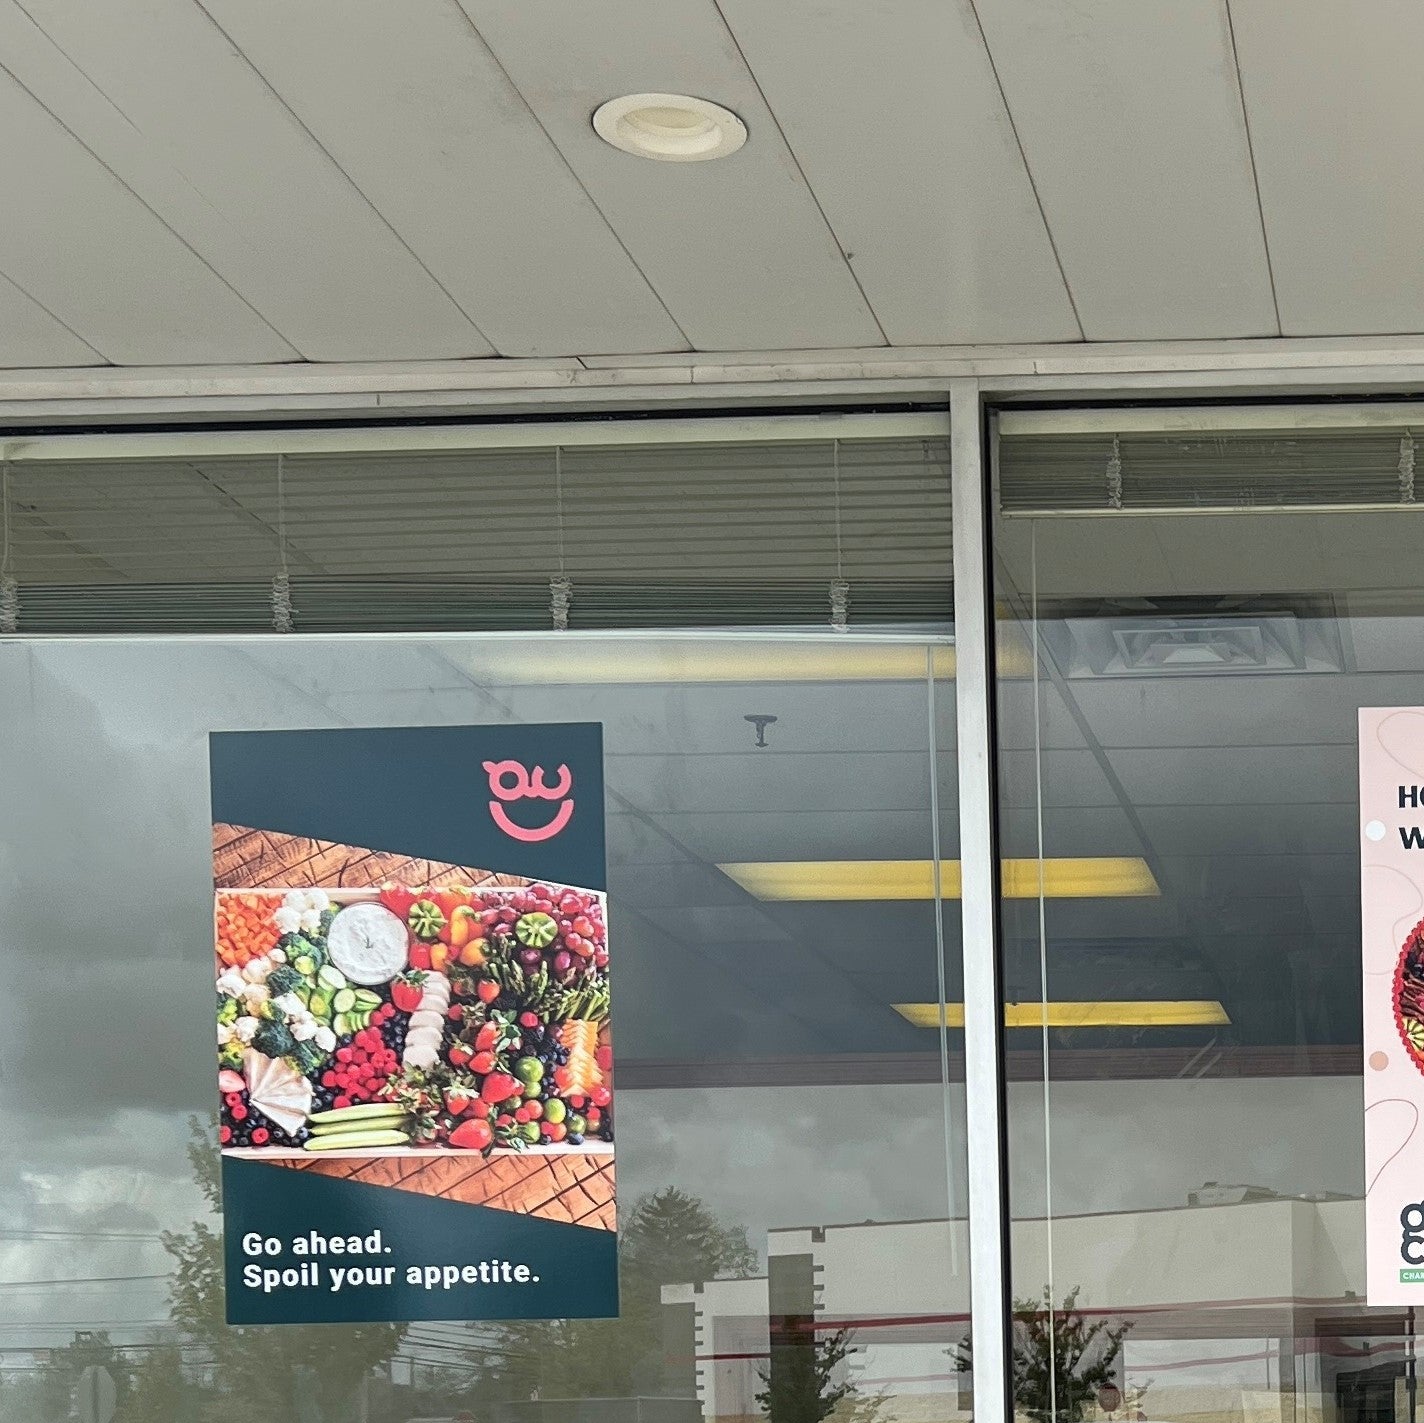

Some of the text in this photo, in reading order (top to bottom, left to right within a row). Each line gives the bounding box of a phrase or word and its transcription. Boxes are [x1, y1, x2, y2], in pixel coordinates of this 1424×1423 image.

[242, 1230, 392, 1255] Go ahead.
[243, 1259, 540, 1292] Spoil your appetite.
